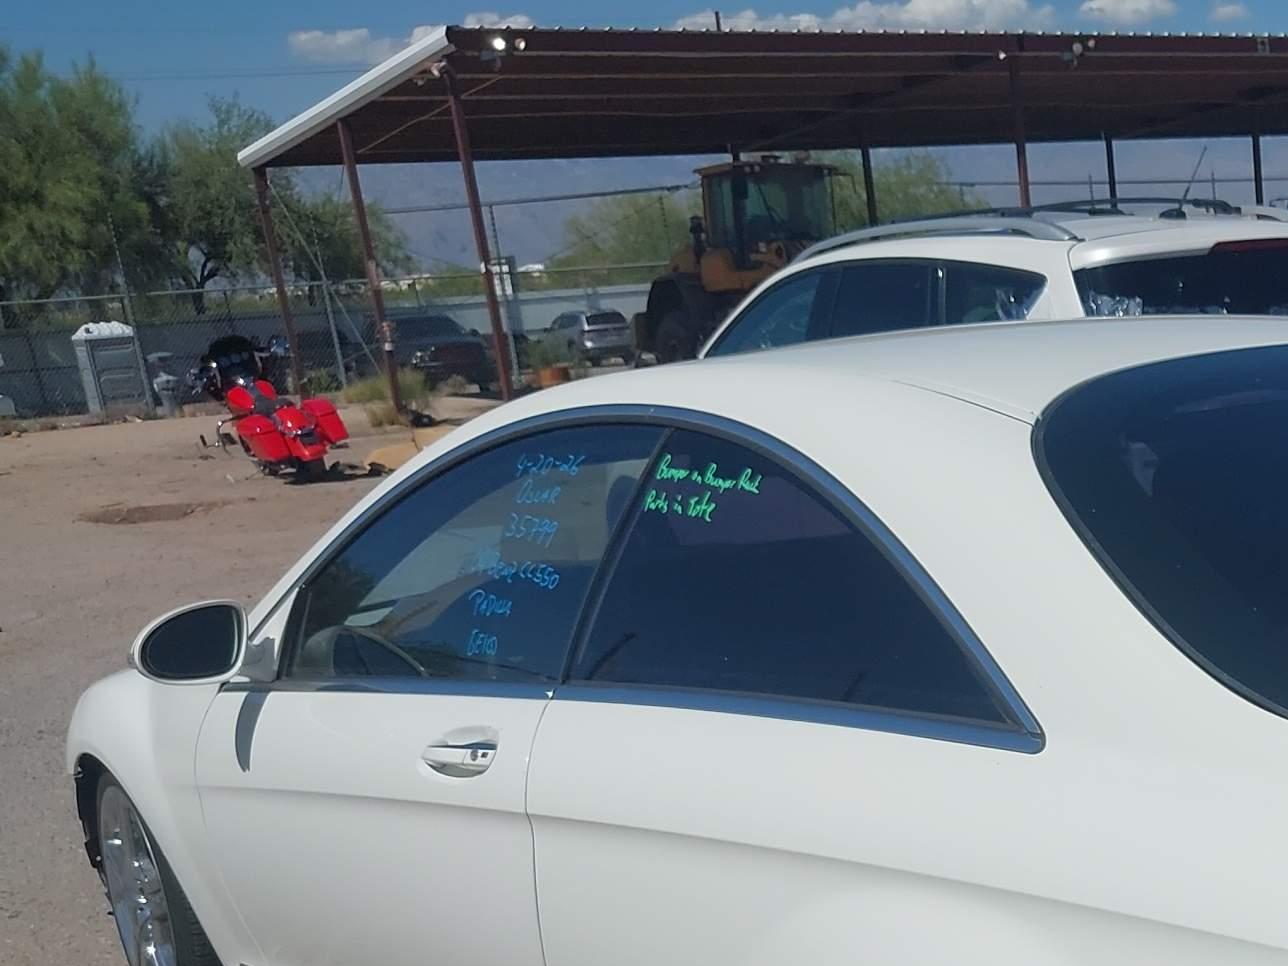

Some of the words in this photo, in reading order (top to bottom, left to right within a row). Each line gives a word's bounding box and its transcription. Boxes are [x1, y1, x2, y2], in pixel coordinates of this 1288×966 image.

[515, 454, 586, 477] 4-20-26
[644, 490, 669, 514] Parts
[673, 495, 683, 514] in
[688, 491, 716, 522] Tote
